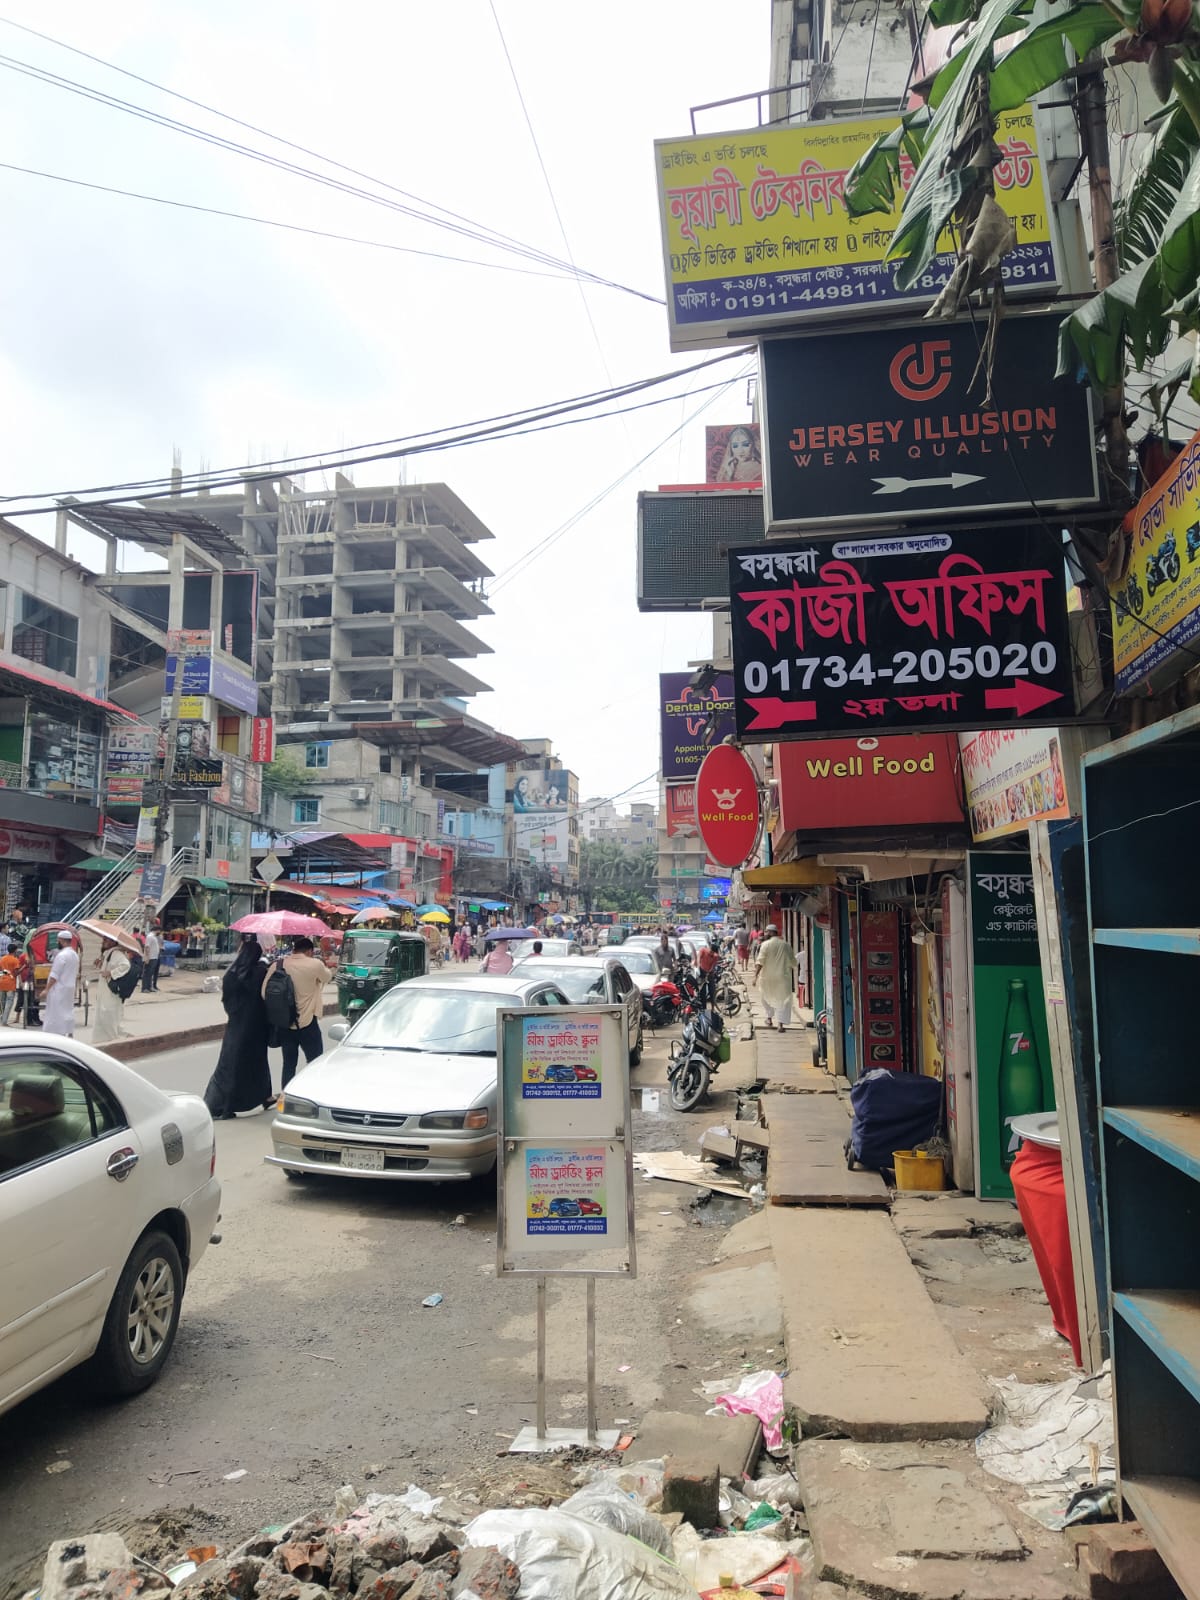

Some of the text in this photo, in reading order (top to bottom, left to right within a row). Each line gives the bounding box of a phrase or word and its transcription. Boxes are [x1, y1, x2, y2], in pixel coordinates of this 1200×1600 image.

[740, 144, 768, 158] চলছে
[667, 167, 744, 244] নূরানী
[862, 228, 895, 249] লাইসে
[677, 288, 708, 311] অফিস
[789, 407, 1057, 451] JERSEY ILLUSION
[794, 434, 1055, 468] WEAR QUALITY
[736, 548, 821, 582] বসুন্ধরা
[737, 560, 875, 651] কাজী
[883, 554, 1053, 640] অফিস
[744, 641, 1057, 693] 01734-205020
[665, 701, 734, 713] Dental Door
[843, 691, 963, 718] ২য় তলা
[807, 753, 935, 778] Well Food
[677, 789, 694, 807] MOB
[702, 813, 724, 821] Well
[729, 812, 754, 821] Food
